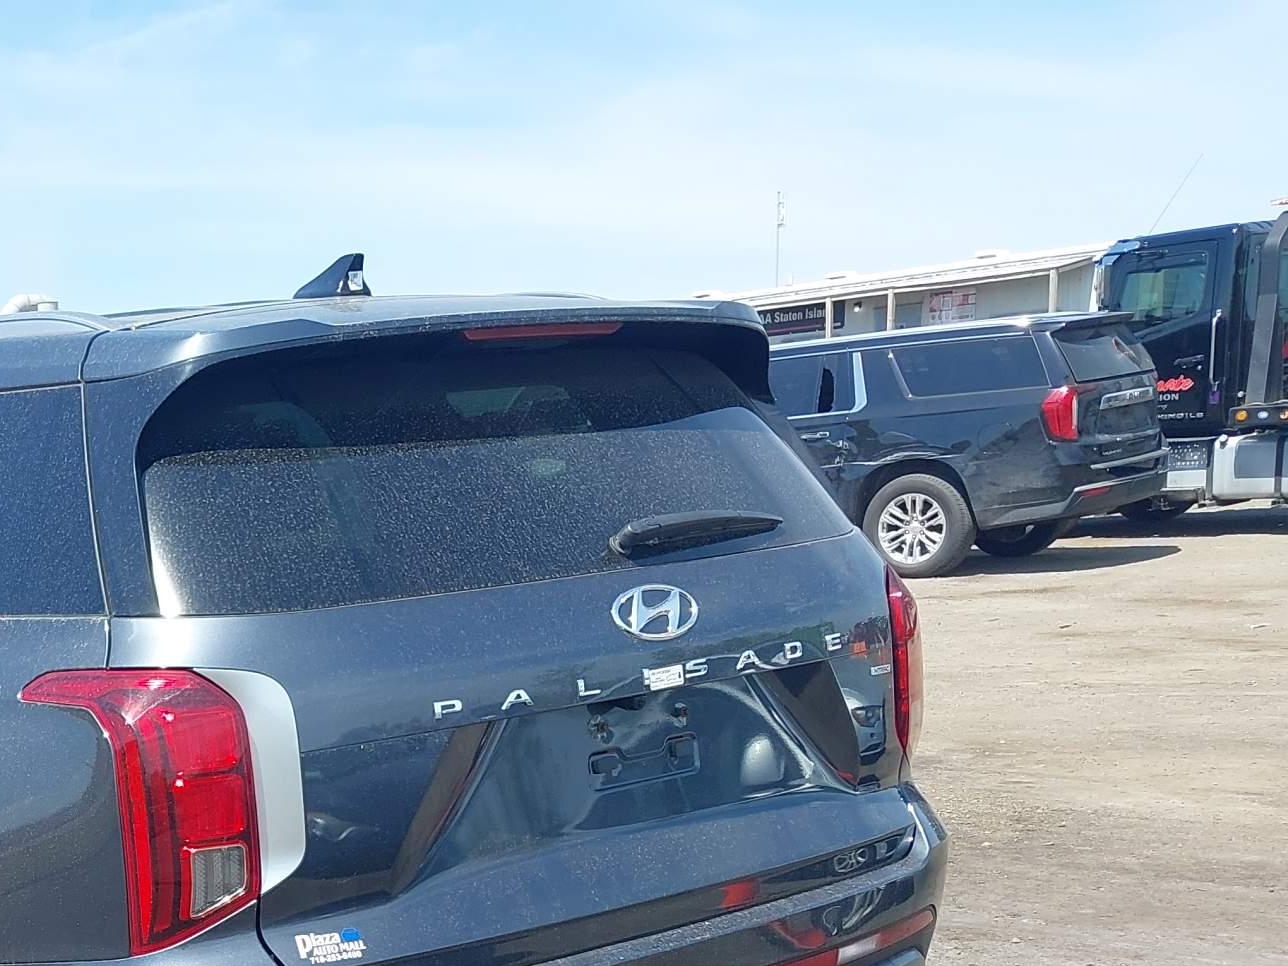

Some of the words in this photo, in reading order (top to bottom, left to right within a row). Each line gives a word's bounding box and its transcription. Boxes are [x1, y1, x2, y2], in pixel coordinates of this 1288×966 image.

[759, 313, 772, 325] AA
[774, 310, 803, 323] Staton
[313, 944, 339, 956] AUTO
[339, 940, 367, 952] MALL
